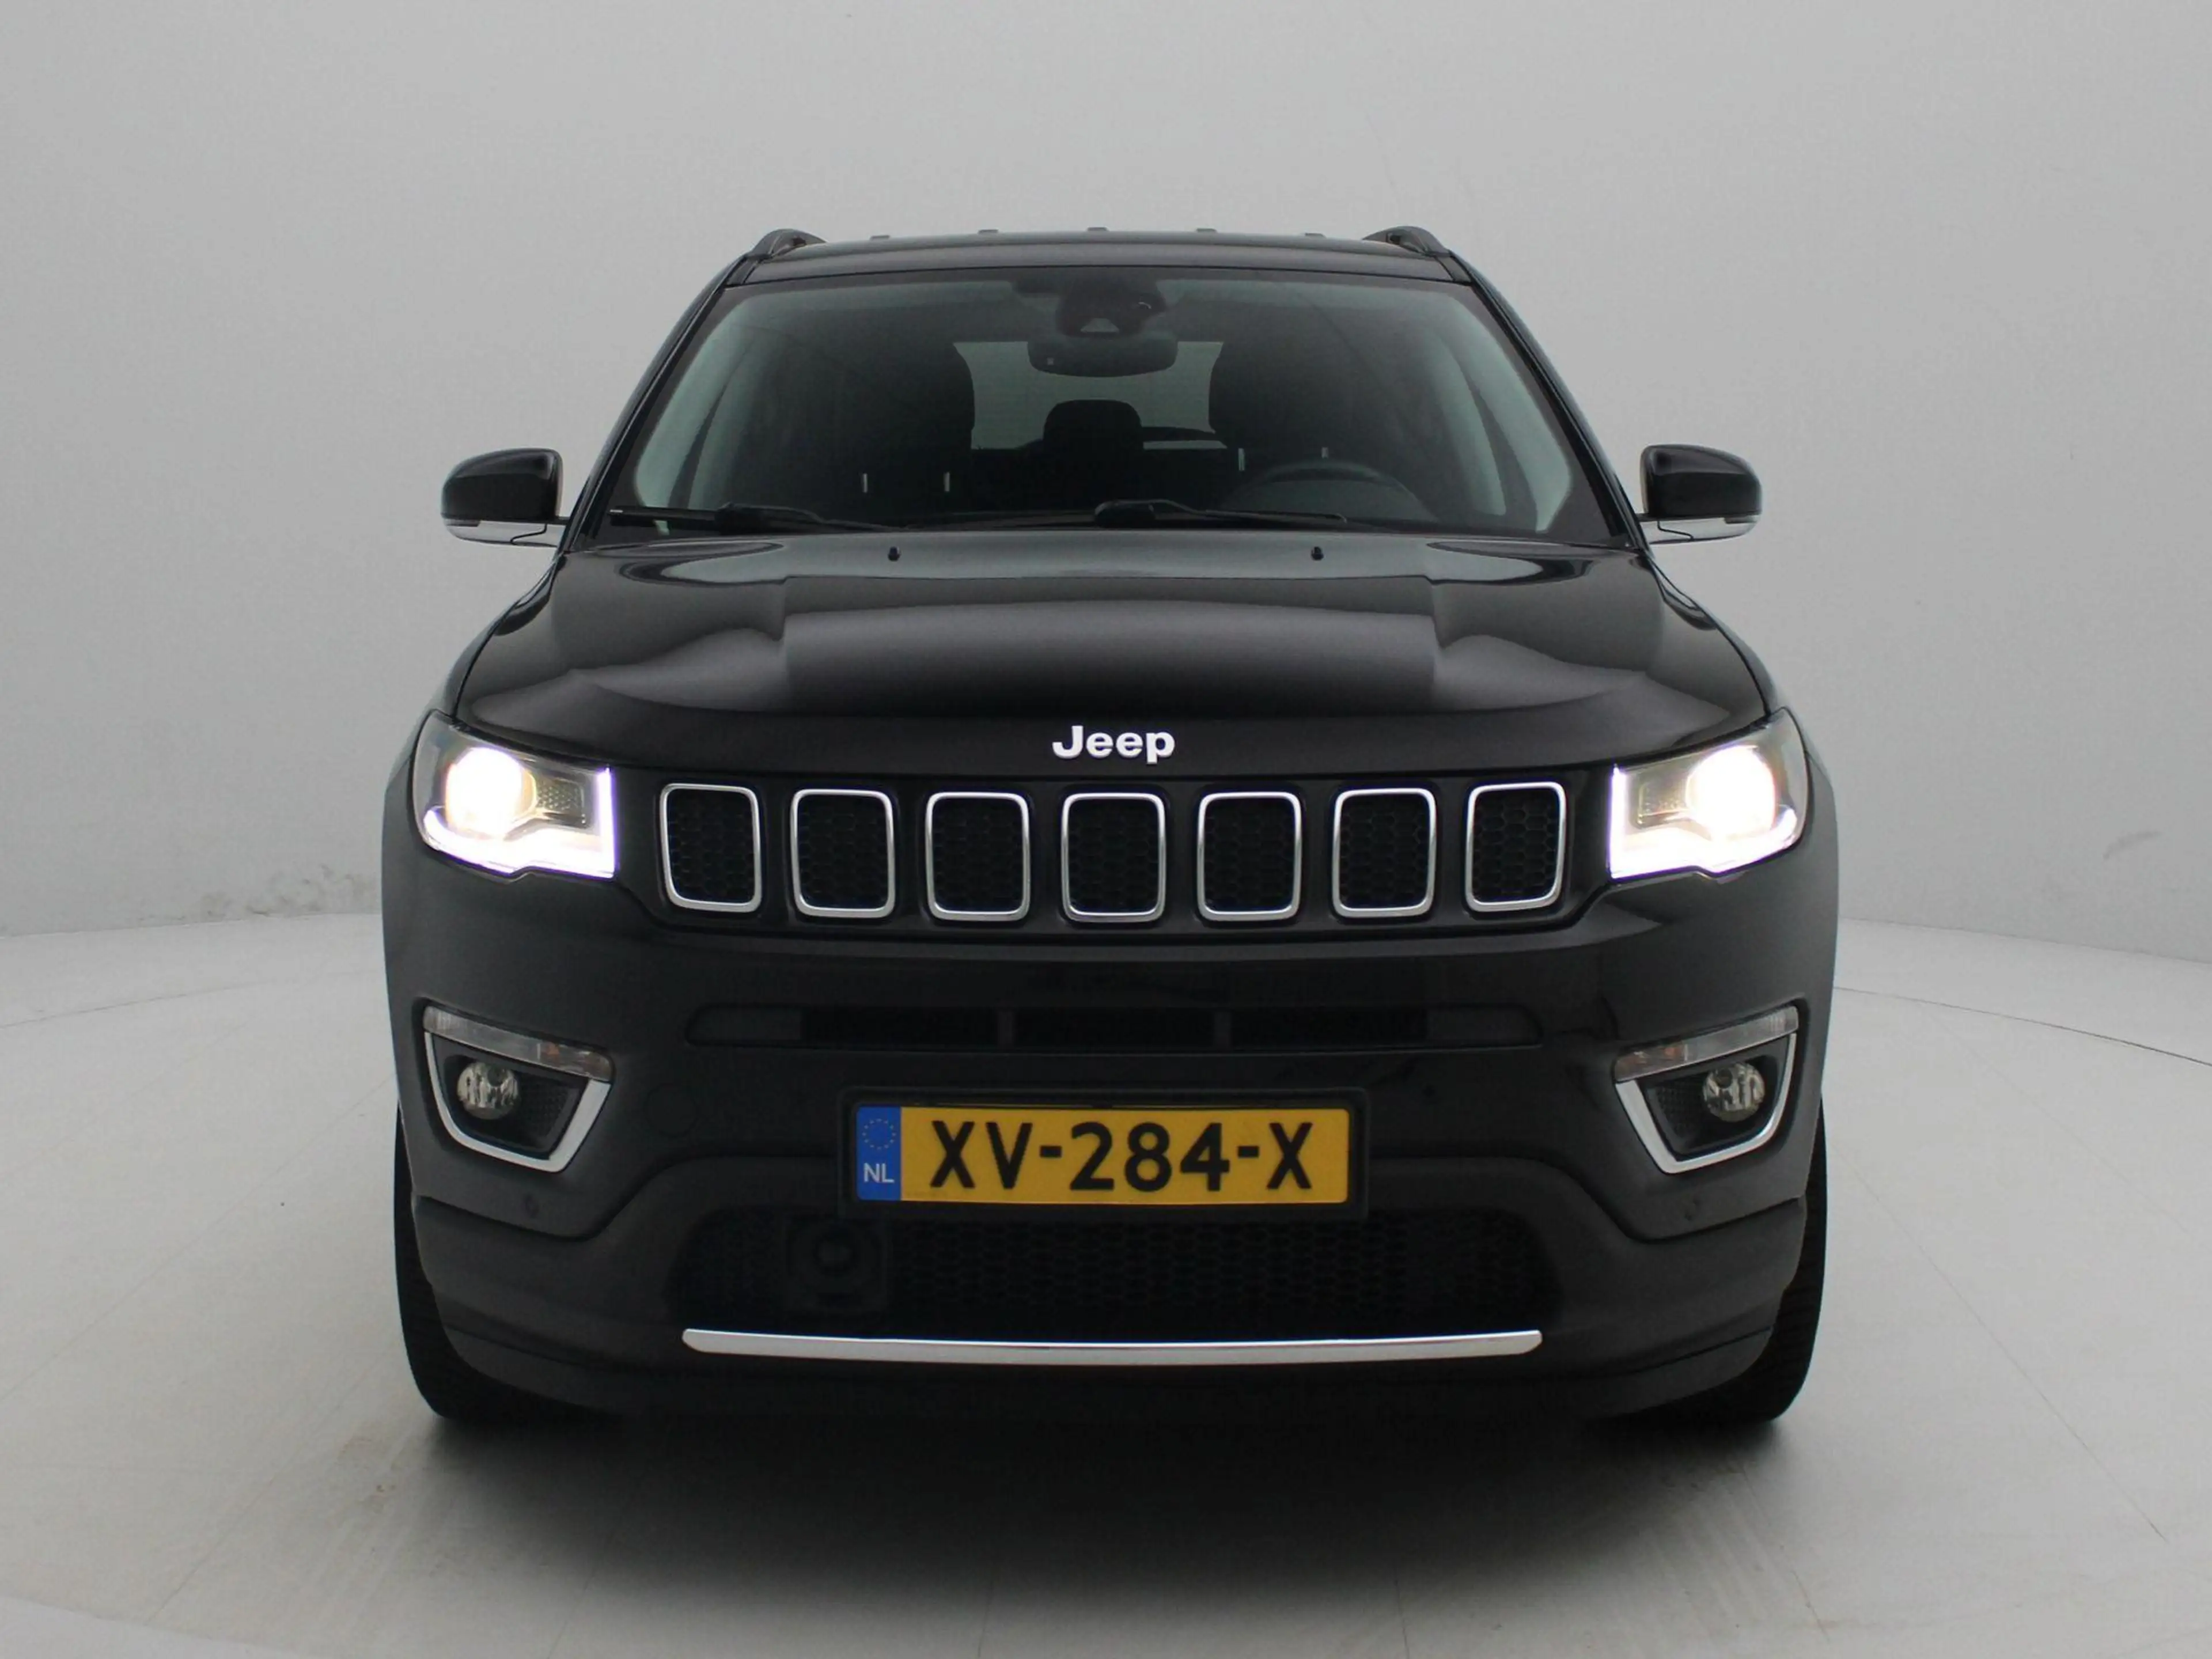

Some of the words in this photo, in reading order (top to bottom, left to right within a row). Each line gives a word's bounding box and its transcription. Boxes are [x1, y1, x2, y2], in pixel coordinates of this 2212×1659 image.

[1052, 725, 1176, 764] Jeep
[863, 1162, 895, 1184] NL
[929, 1120, 1313, 1194] XV-284-X
